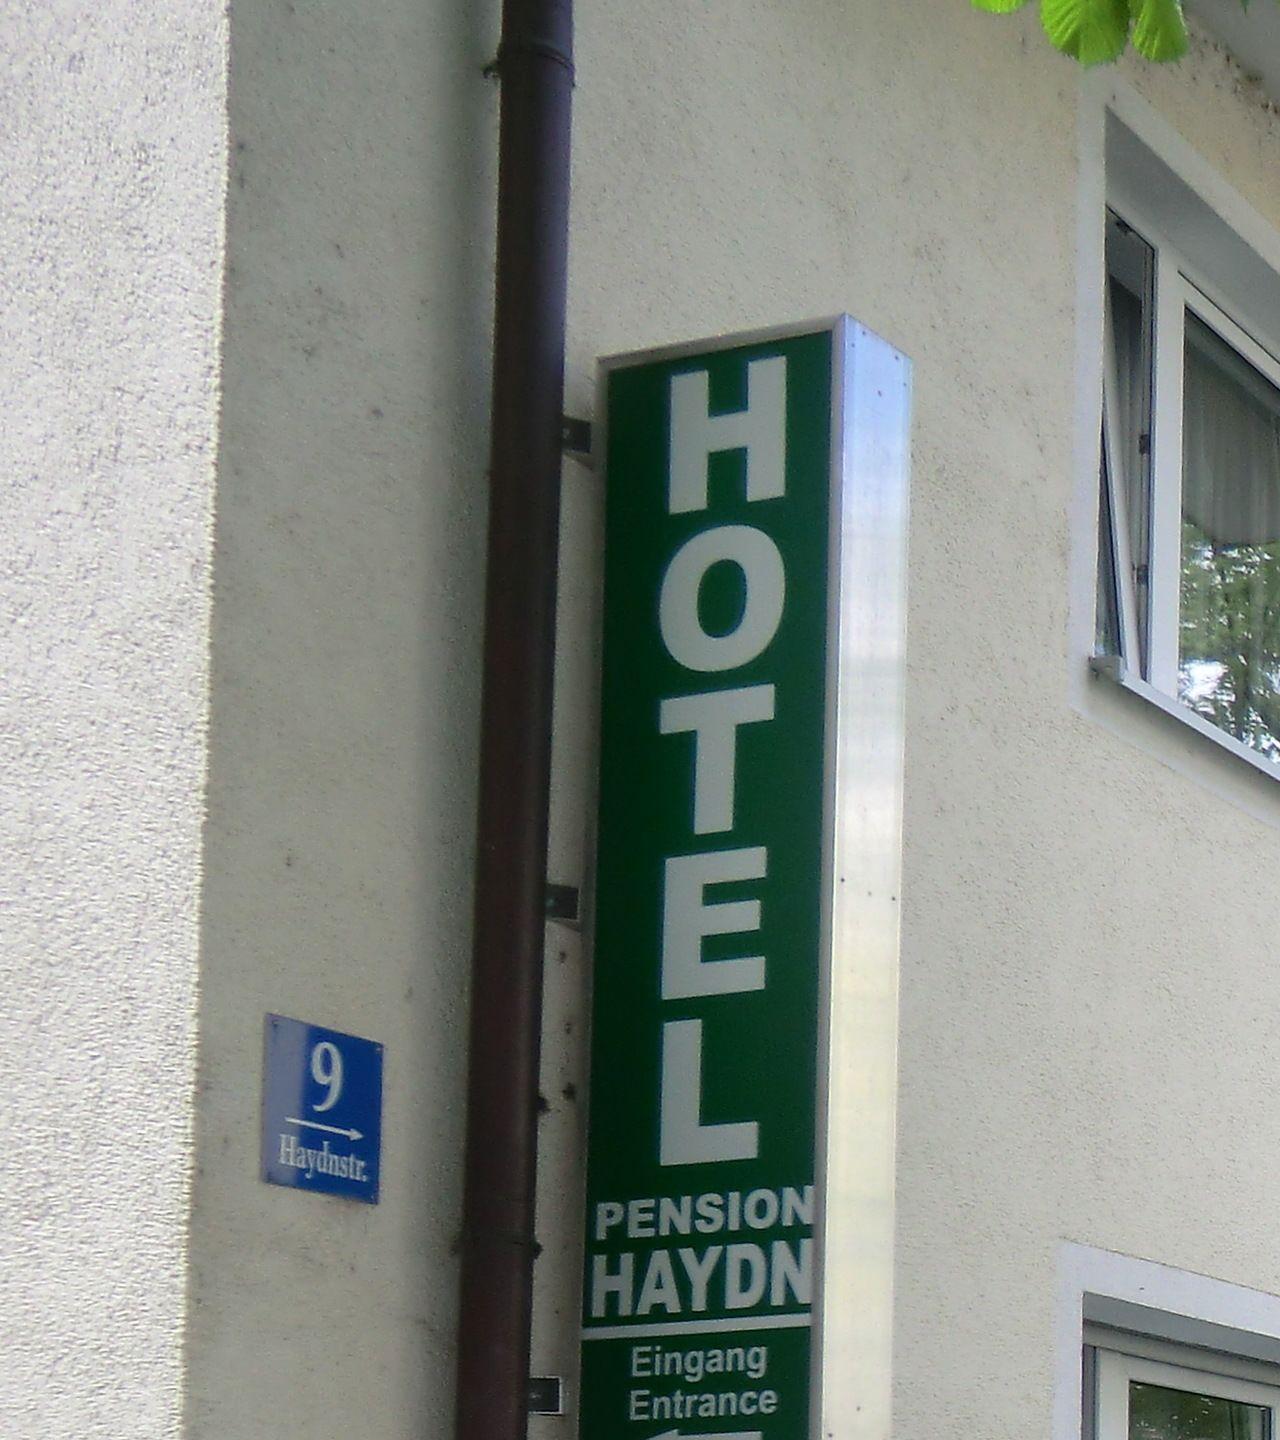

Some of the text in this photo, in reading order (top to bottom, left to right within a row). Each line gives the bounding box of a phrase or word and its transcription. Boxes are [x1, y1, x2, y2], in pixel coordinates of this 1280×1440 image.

[658, 354, 788, 1167] HOTEL
[311, 1041, 343, 1112] 9
[278, 1133, 369, 1182] Haydnstr.
[596, 1184, 814, 1241] PENSION
[591, 1238, 813, 1318] HAYDN
[632, 1345, 768, 1382] Eingang
[629, 1388, 779, 1421] Entrance
